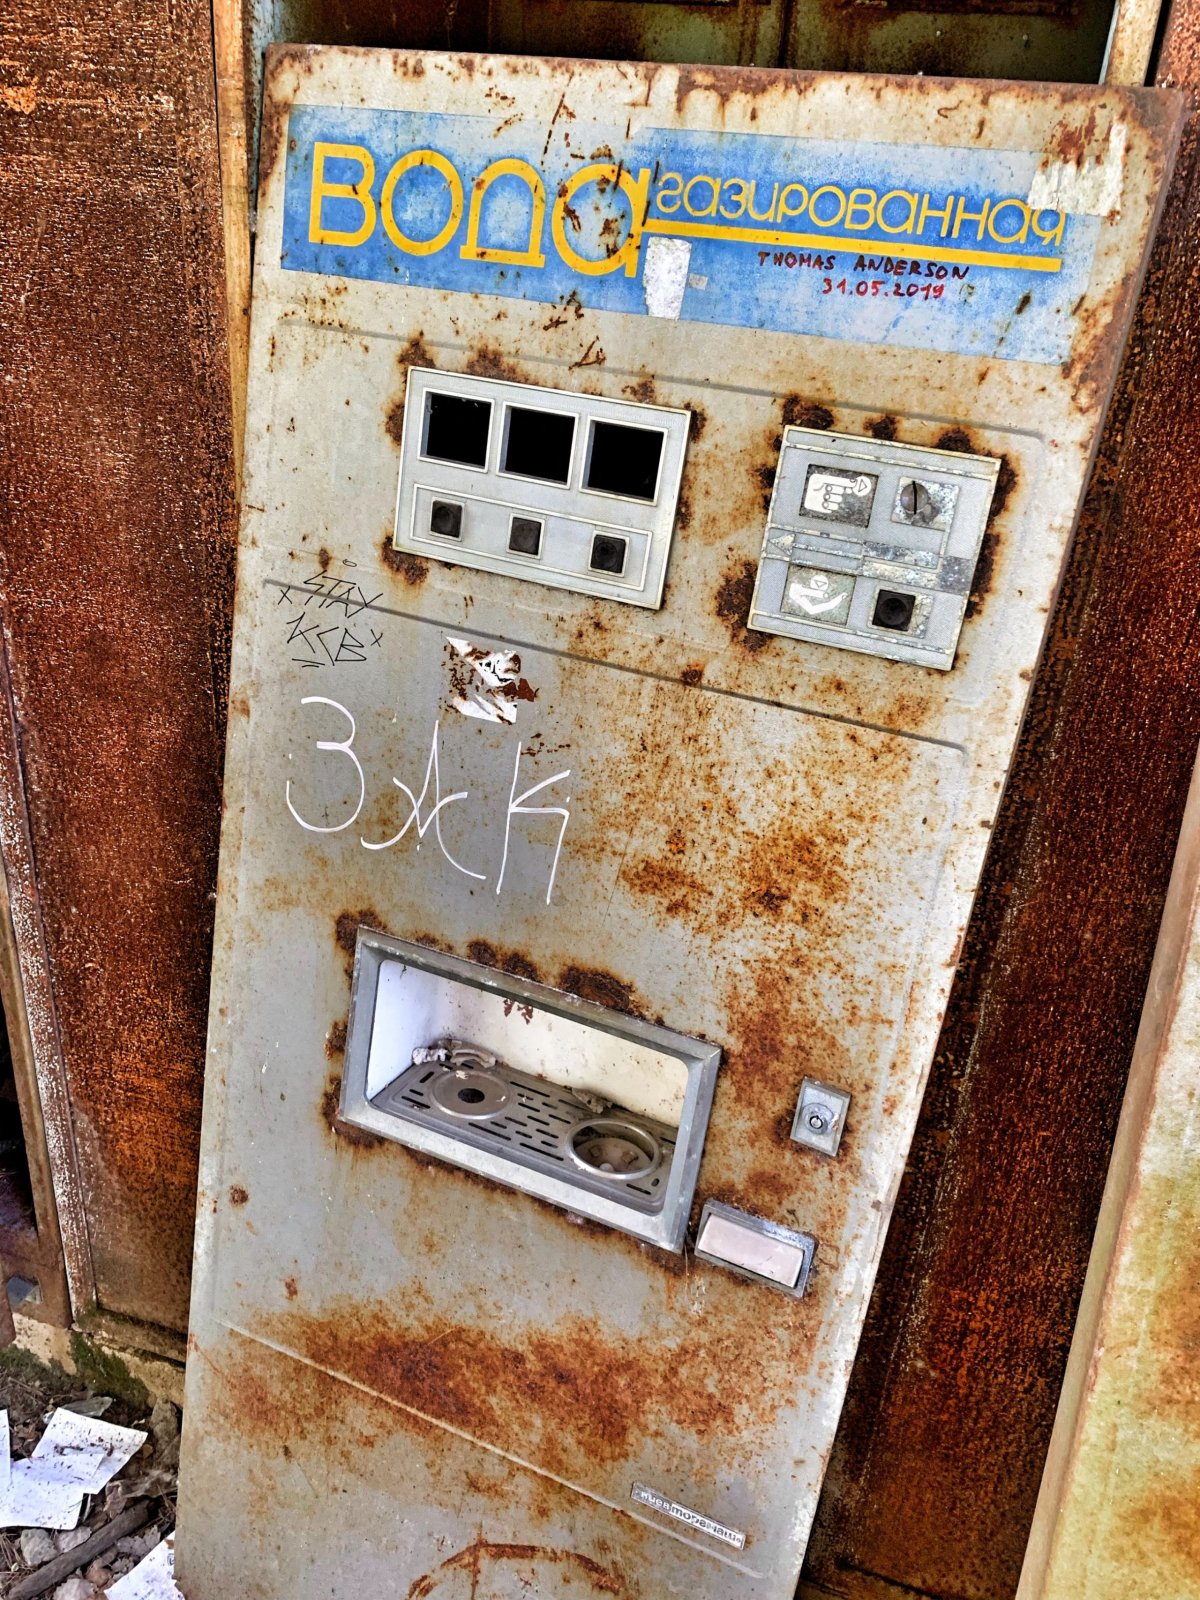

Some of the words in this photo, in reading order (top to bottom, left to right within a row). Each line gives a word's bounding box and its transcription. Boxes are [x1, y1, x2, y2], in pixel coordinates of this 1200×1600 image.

[656, 172, 1066, 246] газированная
[758, 251, 836, 270] THOMAS
[853, 254, 970, 280] ANDERSON
[822, 277, 945, 300] 31.05.2019
